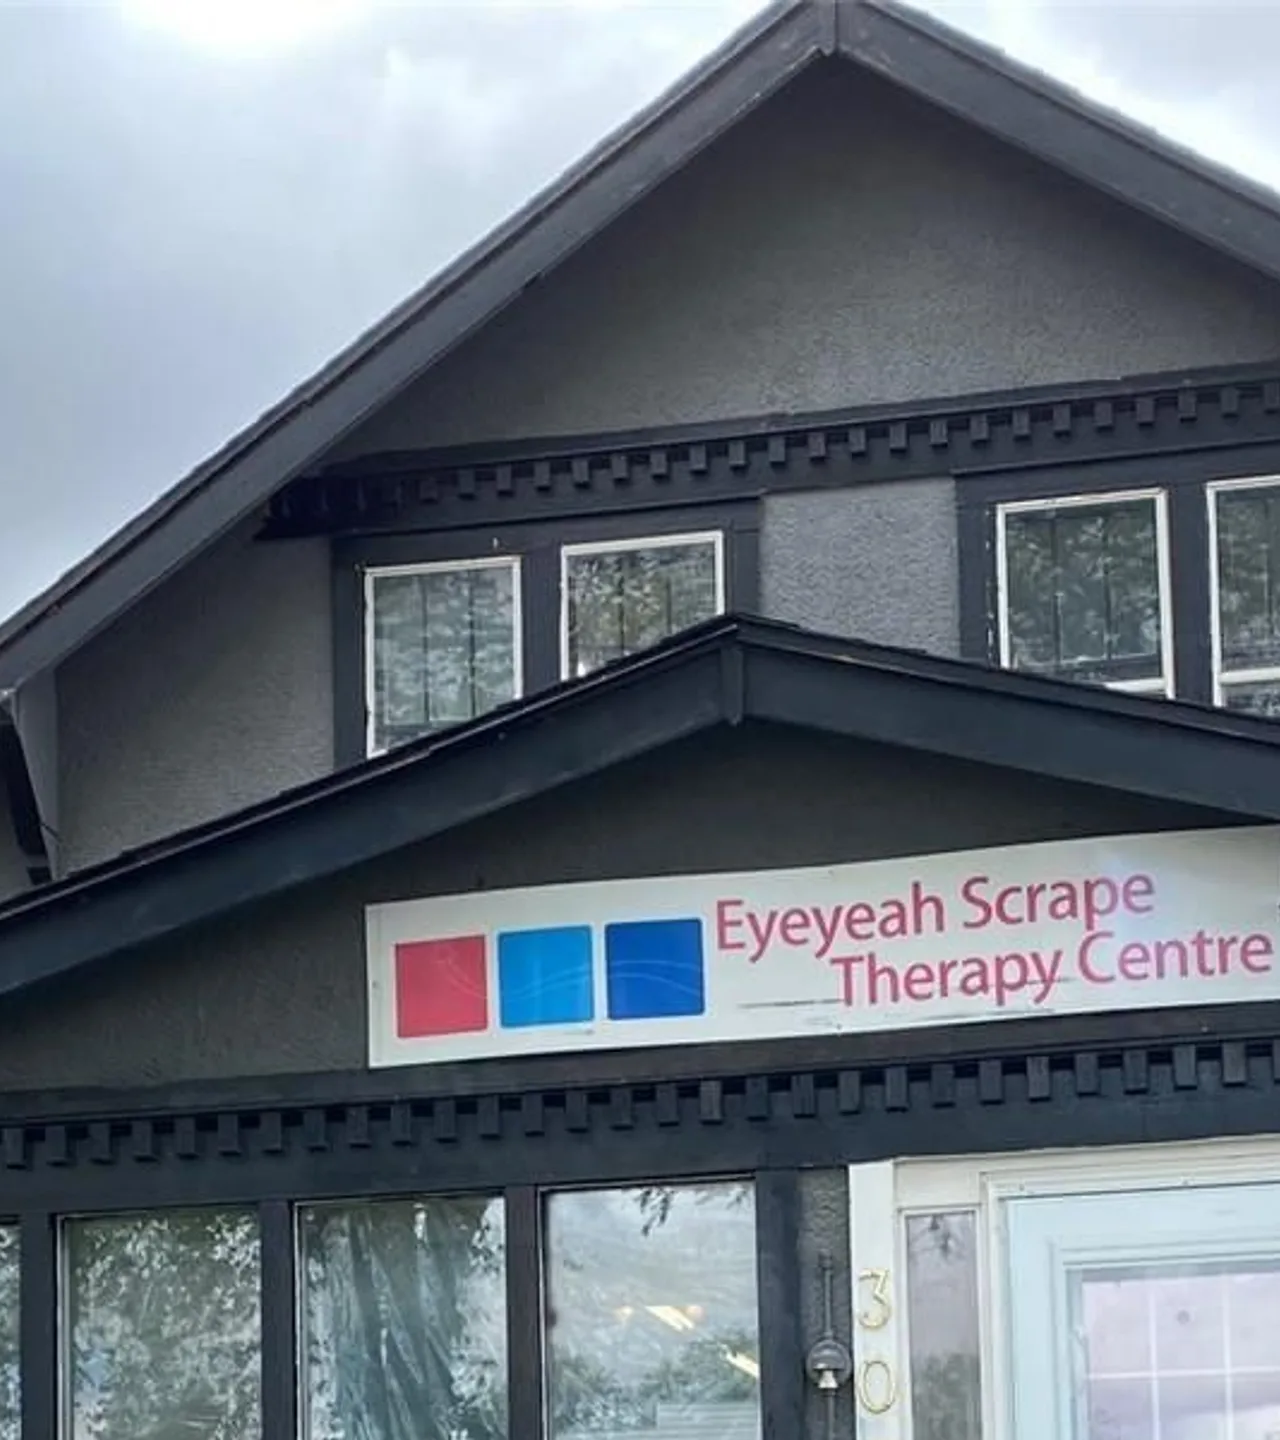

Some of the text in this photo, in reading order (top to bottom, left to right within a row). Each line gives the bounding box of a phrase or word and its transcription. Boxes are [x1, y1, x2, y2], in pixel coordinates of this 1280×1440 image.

[716, 874, 1156, 964] Eyeyeah Scrape
[829, 929, 1273, 1006] Therapy Centre
